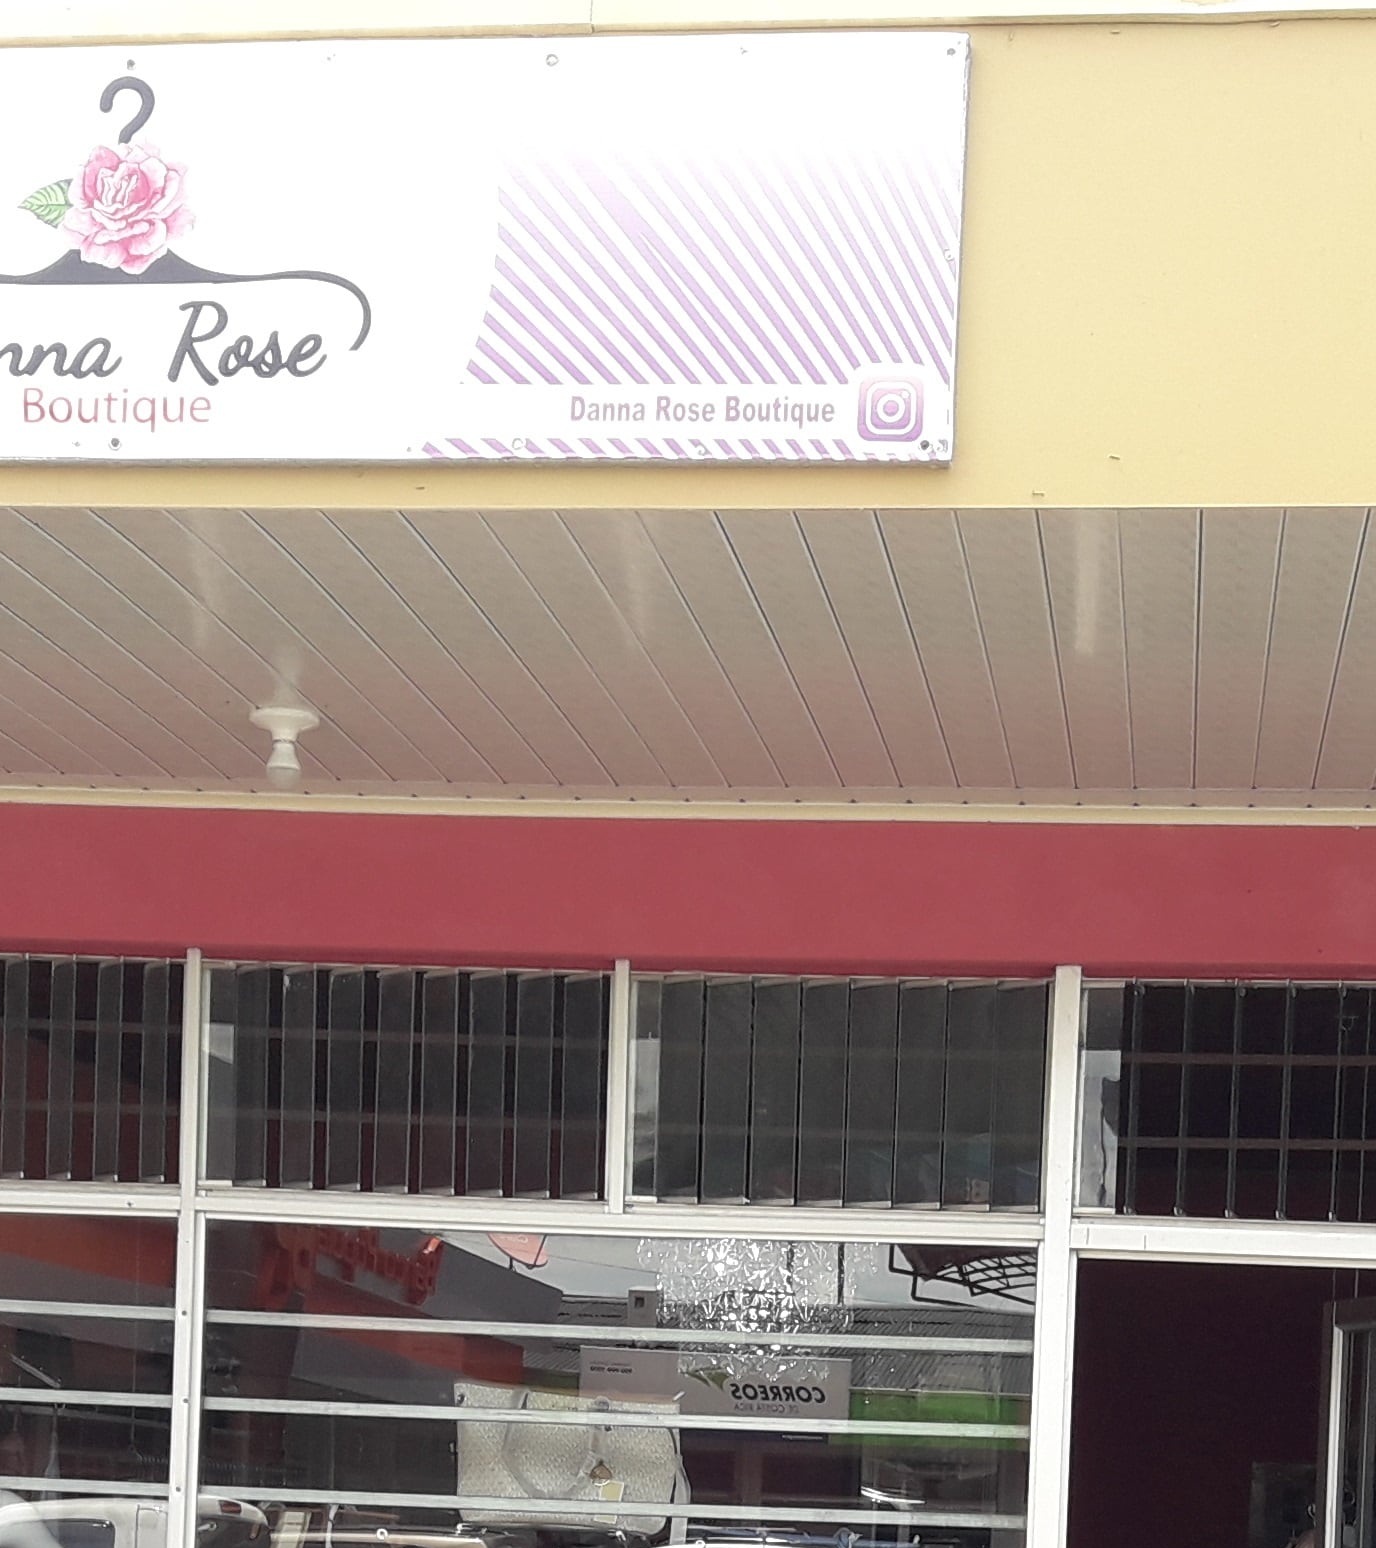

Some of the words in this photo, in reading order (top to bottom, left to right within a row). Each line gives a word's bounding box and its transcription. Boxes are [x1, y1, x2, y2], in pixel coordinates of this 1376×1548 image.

[167, 300, 327, 386] Rose
[23, 387, 212, 433] Boutique
[570, 395, 645, 422] Danna
[655, 395, 715, 422] Rose
[725, 395, 835, 430] Boutique
